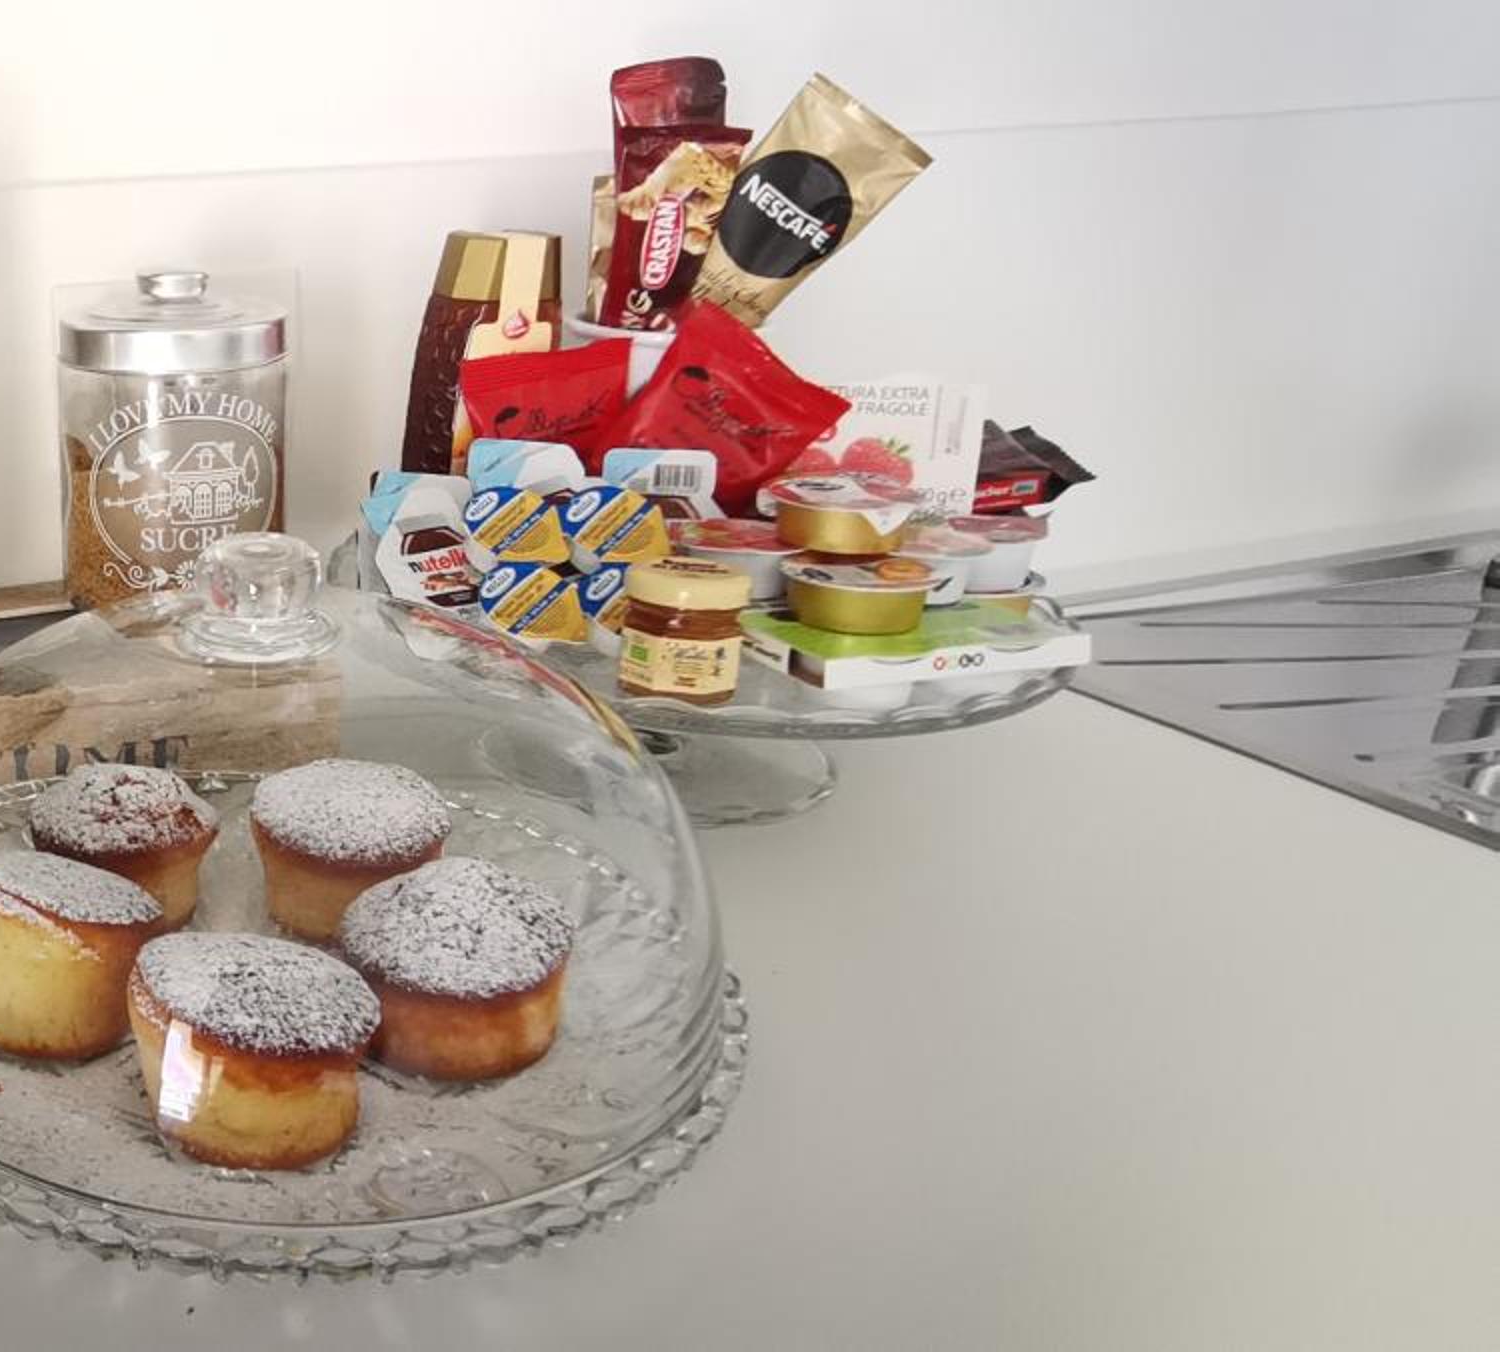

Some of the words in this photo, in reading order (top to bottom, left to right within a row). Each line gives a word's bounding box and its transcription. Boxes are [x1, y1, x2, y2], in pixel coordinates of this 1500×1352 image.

[643, 200, 679, 286] CRASTAN
[881, 385, 929, 399] EXTRA
[168, 392, 212, 416] MY
[217, 394, 277, 443] HOME
[857, 401, 931, 416] FRAGOLE
[408, 547, 468, 574] nutell
